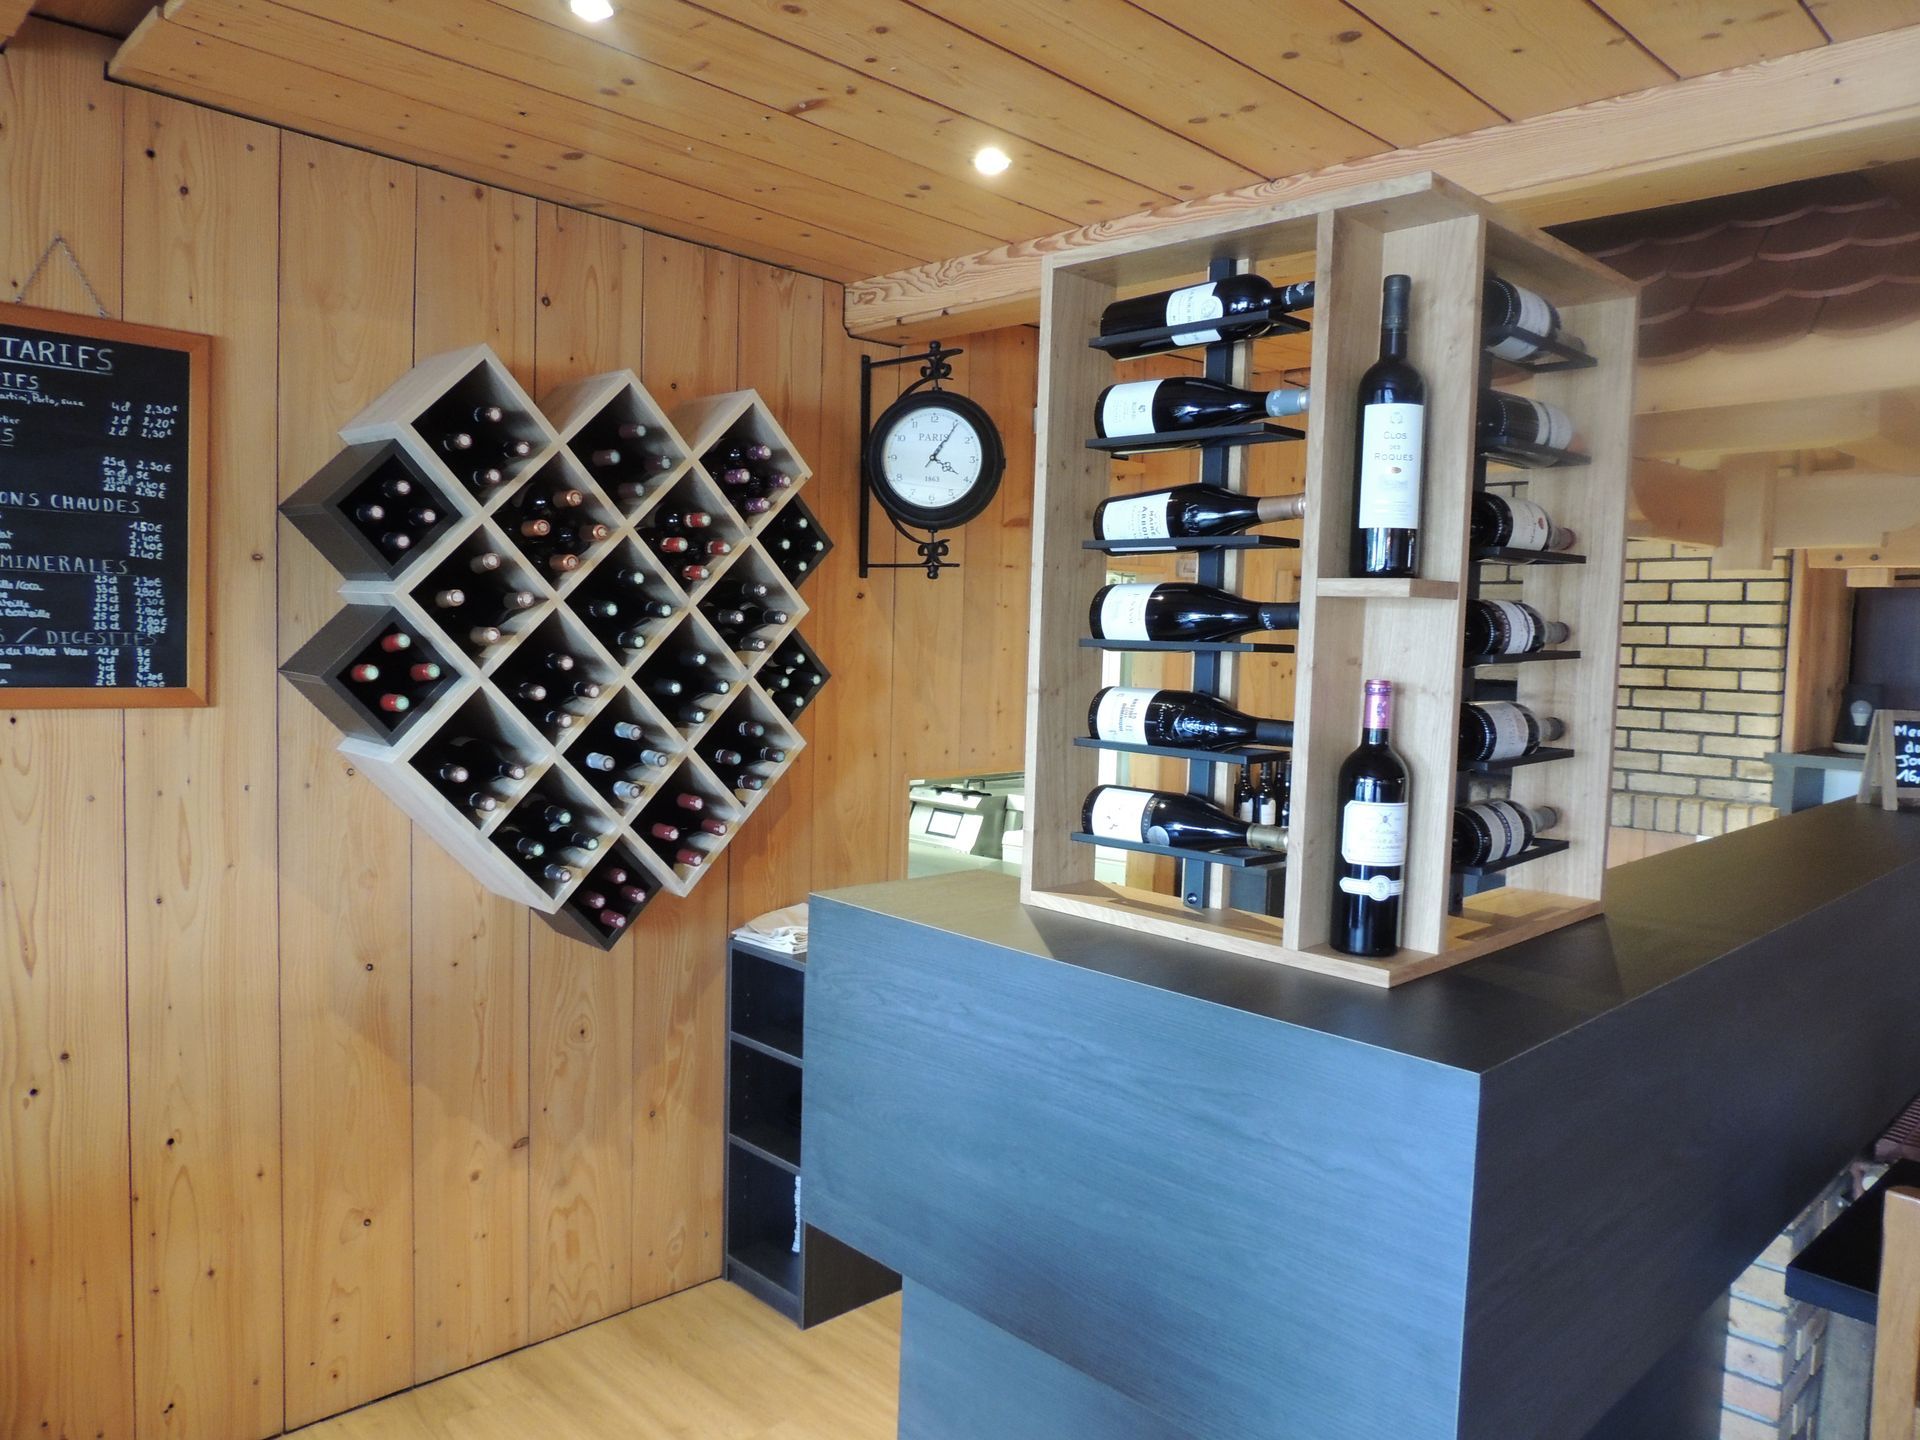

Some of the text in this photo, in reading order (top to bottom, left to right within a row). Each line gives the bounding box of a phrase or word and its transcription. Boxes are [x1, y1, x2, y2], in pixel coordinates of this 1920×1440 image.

[0, 337, 113, 371] TARIFS
[930, 415, 939, 423] 12
[918, 432, 949, 442] PARIS
[50, 494, 140, 514] CHAUDES
[0, 555, 128, 574] MINERALES
